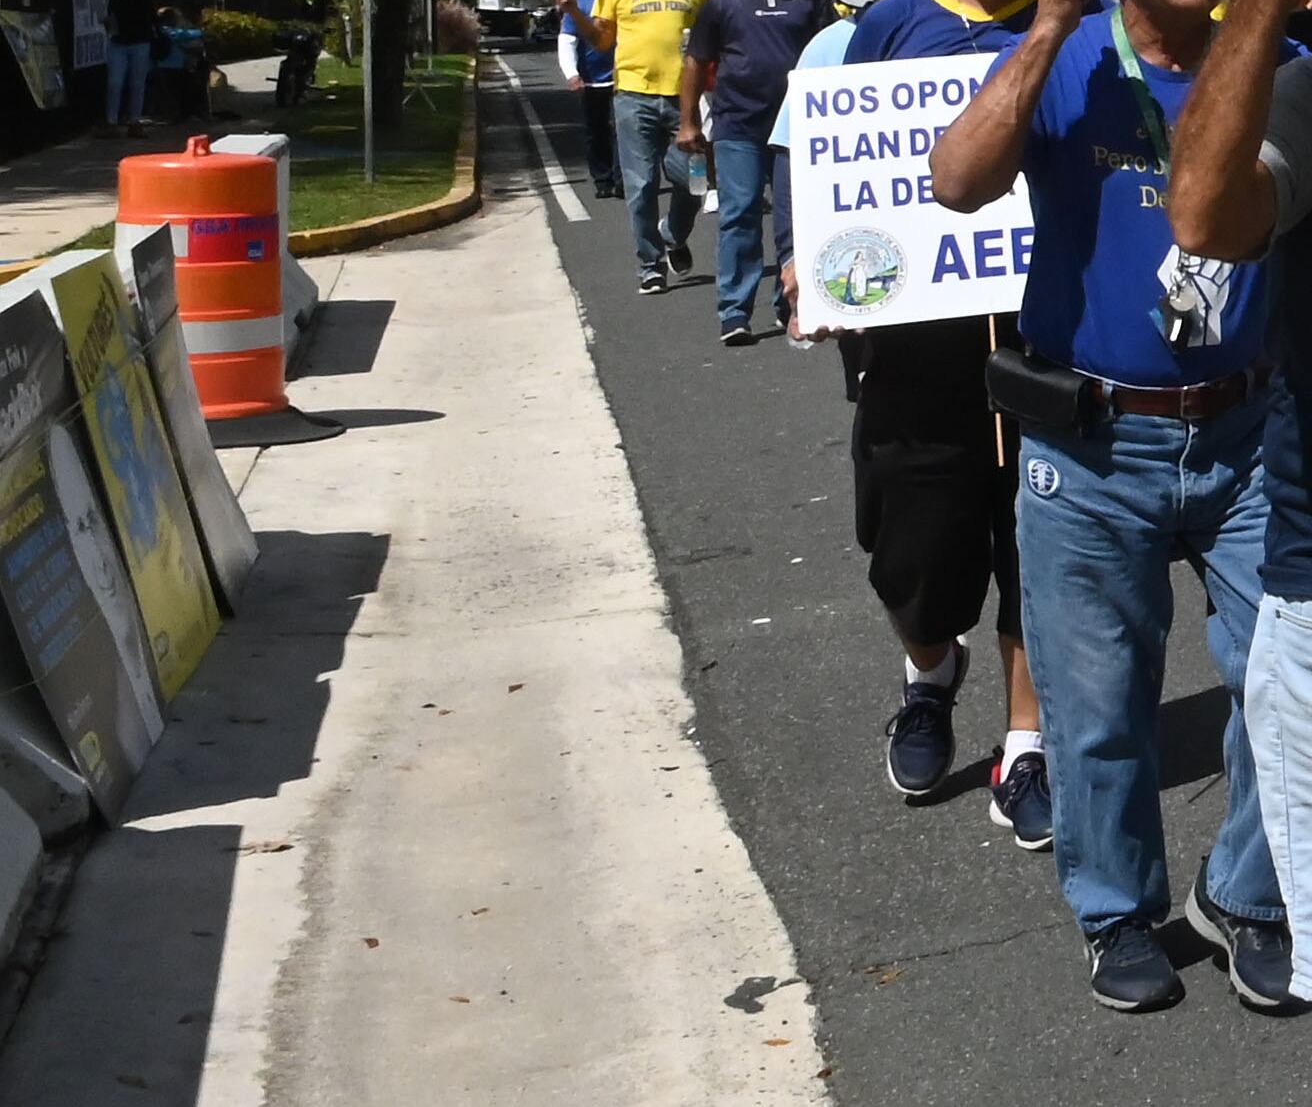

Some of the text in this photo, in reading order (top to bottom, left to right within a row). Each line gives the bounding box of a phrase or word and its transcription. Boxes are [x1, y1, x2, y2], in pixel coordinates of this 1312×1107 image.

[806, 86, 879, 119] NOS
[809, 129, 900, 165] PLAN
[1092, 145, 1147, 173] Pero
[833, 175, 933, 212] LA DE
[931, 226, 1036, 284] AEE
